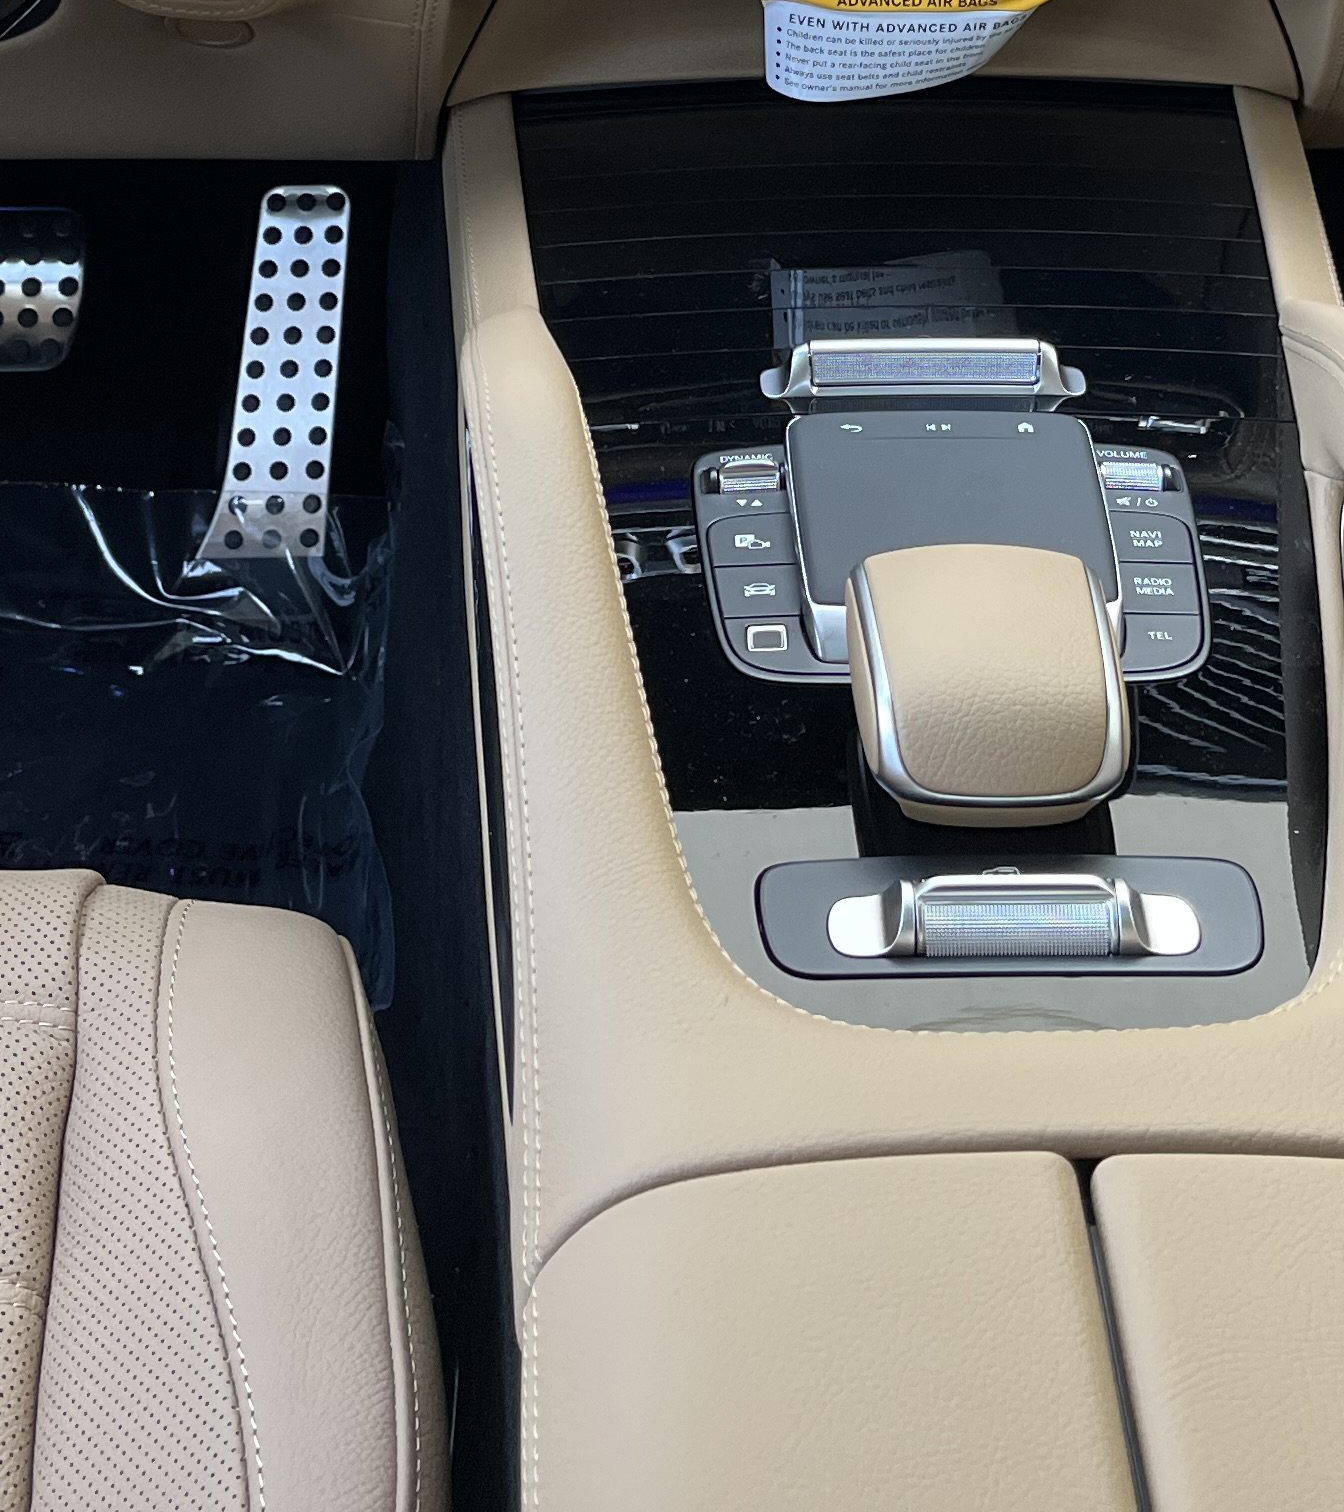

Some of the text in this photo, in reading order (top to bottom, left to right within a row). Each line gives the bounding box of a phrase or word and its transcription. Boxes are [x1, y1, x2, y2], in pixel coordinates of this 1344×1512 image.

[789, 13, 987, 34] EVEN WITH ADVANCED AIR
[786, 28, 824, 42] Children
[826, 36, 842, 44] can
[845, 36, 856, 45] be
[859, 37, 884, 46] killed
[898, 38, 939, 47] seriously
[942, 35, 974, 45] injured
[785, 40, 802, 52] The
[803, 44, 824, 55] back
[827, 48, 847, 57] seat
[850, 49, 857, 57] is
[860, 49, 875, 57] the
[878, 49, 906, 58] safest
[908, 49, 932, 59] place
[935, 47, 949, 55] for
[785, 52, 810, 65] Never
[812, 60, 827, 69] put
[838, 62, 887, 71] rear-facing
[890, 60, 912, 68] child
[915, 58, 933, 66] seat
[784, 66, 814, 80] Always
[835, 73, 855, 81] seat
[858, 72, 880, 81] belts
[882, 72, 900, 80] and
[902, 69, 923, 78] child
[840, 83, 873, 92] manual
[719, 453, 773, 463] DYNAMIC
[1096, 450, 1147, 459] VOLUME
[1130, 530, 1161, 538] NAVI
[1134, 577, 1171, 585] RADIO
[1136, 587, 1174, 595] MEDIA
[1148, 631, 1173, 640] TEL
